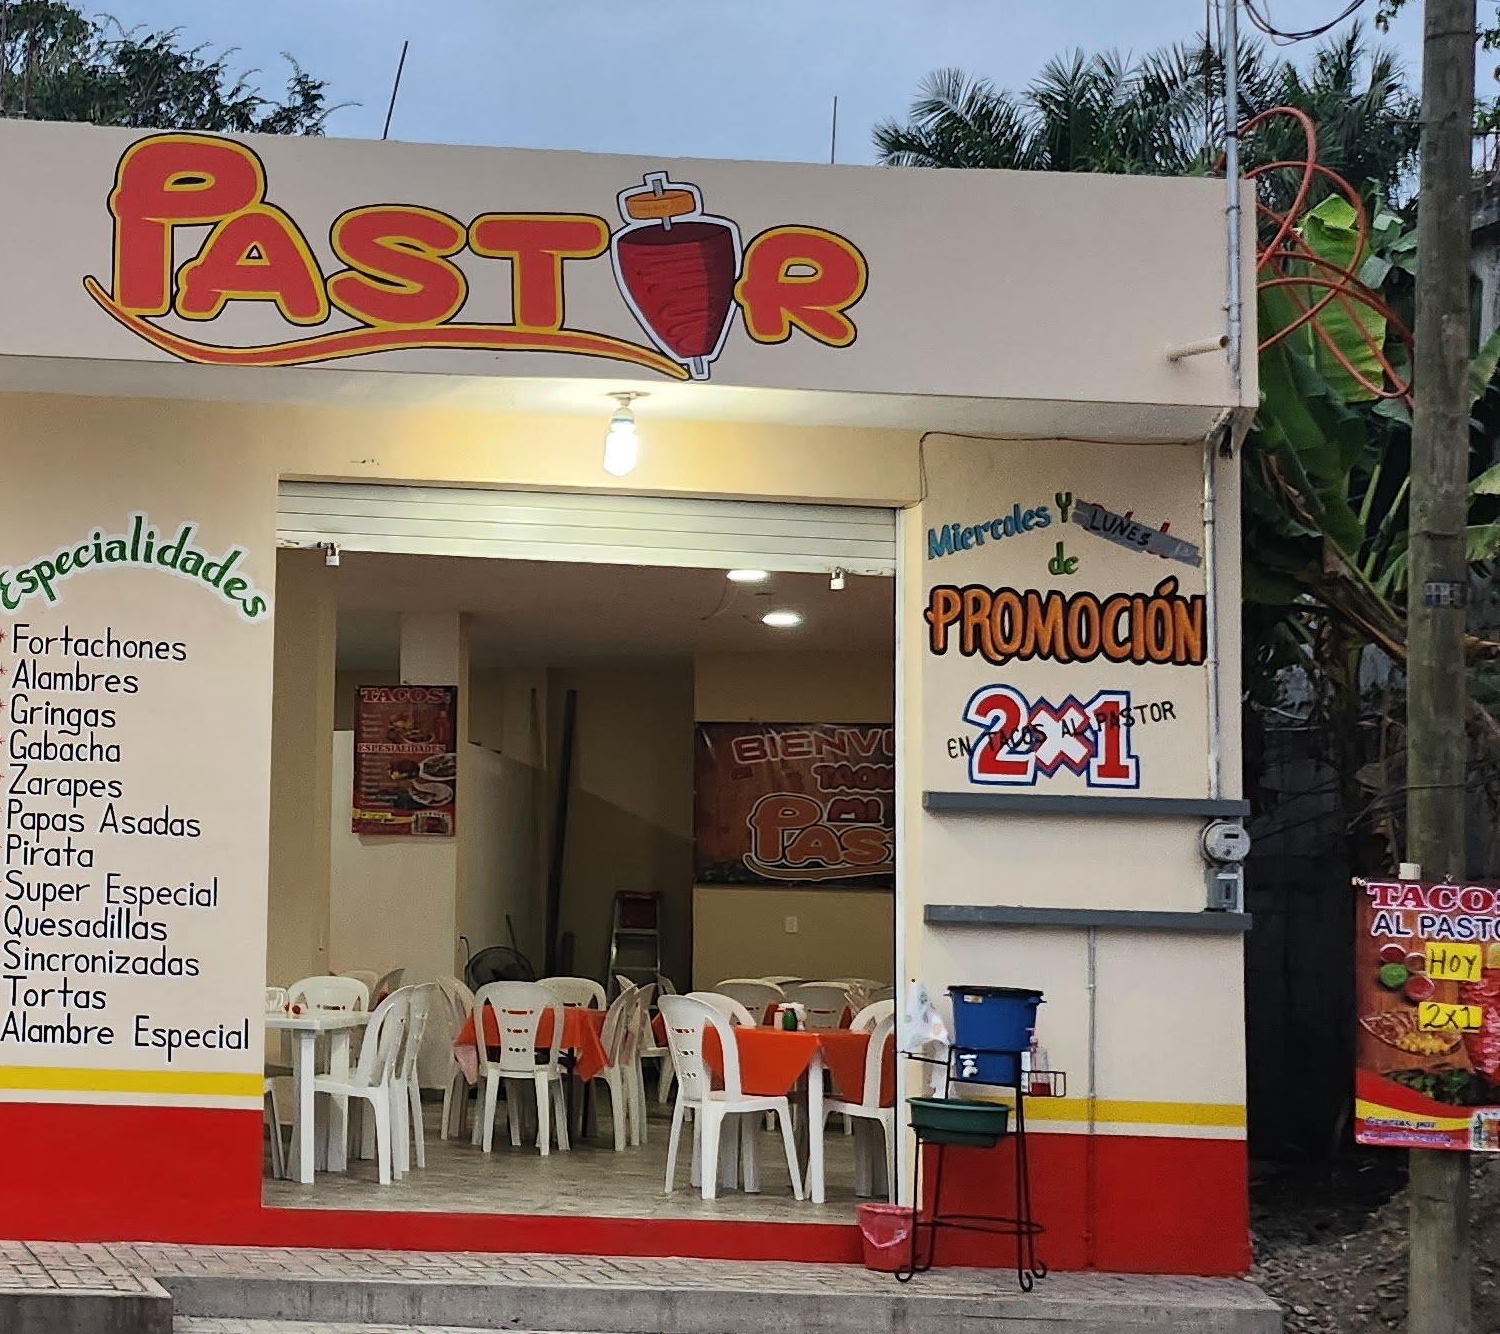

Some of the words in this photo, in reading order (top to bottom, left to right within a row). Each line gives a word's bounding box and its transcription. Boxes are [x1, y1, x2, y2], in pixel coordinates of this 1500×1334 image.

[927, 503, 1052, 560] Miercoles
[1089, 508, 1153, 547] LUNES
[1047, 541, 1079, 575] de
[924, 575, 1207, 666] PROMOCIÓN
[12, 623, 188, 661] Fortachones
[11, 658, 139, 693] Alambres
[10, 693, 116, 736] Gringas
[947, 736, 971, 758] EN
[985, 723, 1048, 752] TACOS
[1061, 717, 1084, 739] AL
[1093, 700, 1177, 733] PASTOR
[9, 728, 121, 763] Gabacha
[8, 763, 123, 808] Zarapes
[7, 798, 85, 843] Papas
[99, 803, 202, 837] Asadas
[747, 792, 893, 866] PAS
[6, 834, 94, 868] Pirata
[5, 870, 91, 911] Super
[106, 873, 218, 916] Especial
[1367, 882, 1500, 914] TACO
[4, 904, 168, 941] Quesadillas
[1371, 911, 1412, 937] AL
[3, 939, 200, 976] Sincronizadas
[1430, 949, 1477, 978] HOY
[3, 975, 107, 1010] Tortas
[0, 1011, 114, 1045] Alambre
[134, 1015, 249, 1062] Especial
